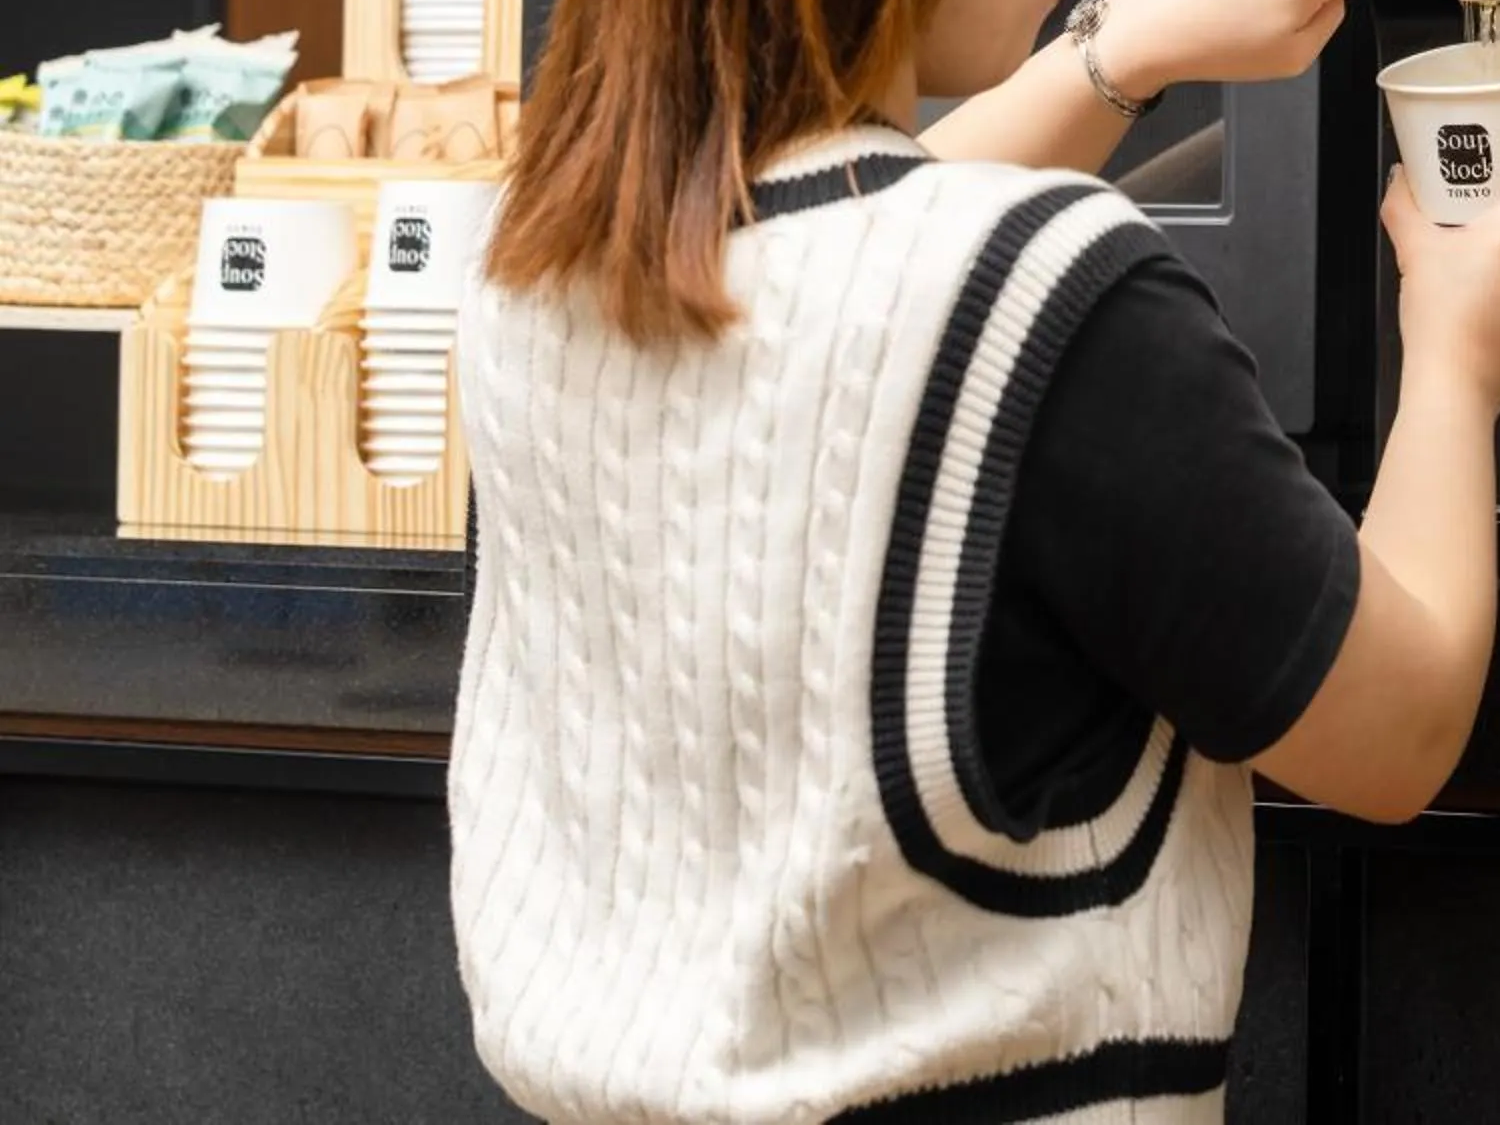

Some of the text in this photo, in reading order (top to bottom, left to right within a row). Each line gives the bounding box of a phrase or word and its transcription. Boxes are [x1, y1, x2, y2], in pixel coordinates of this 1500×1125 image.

[1437, 128, 1490, 154] Soup
[1438, 158, 1493, 180] Stock
[1447, 188, 1491, 198] TOKYO
